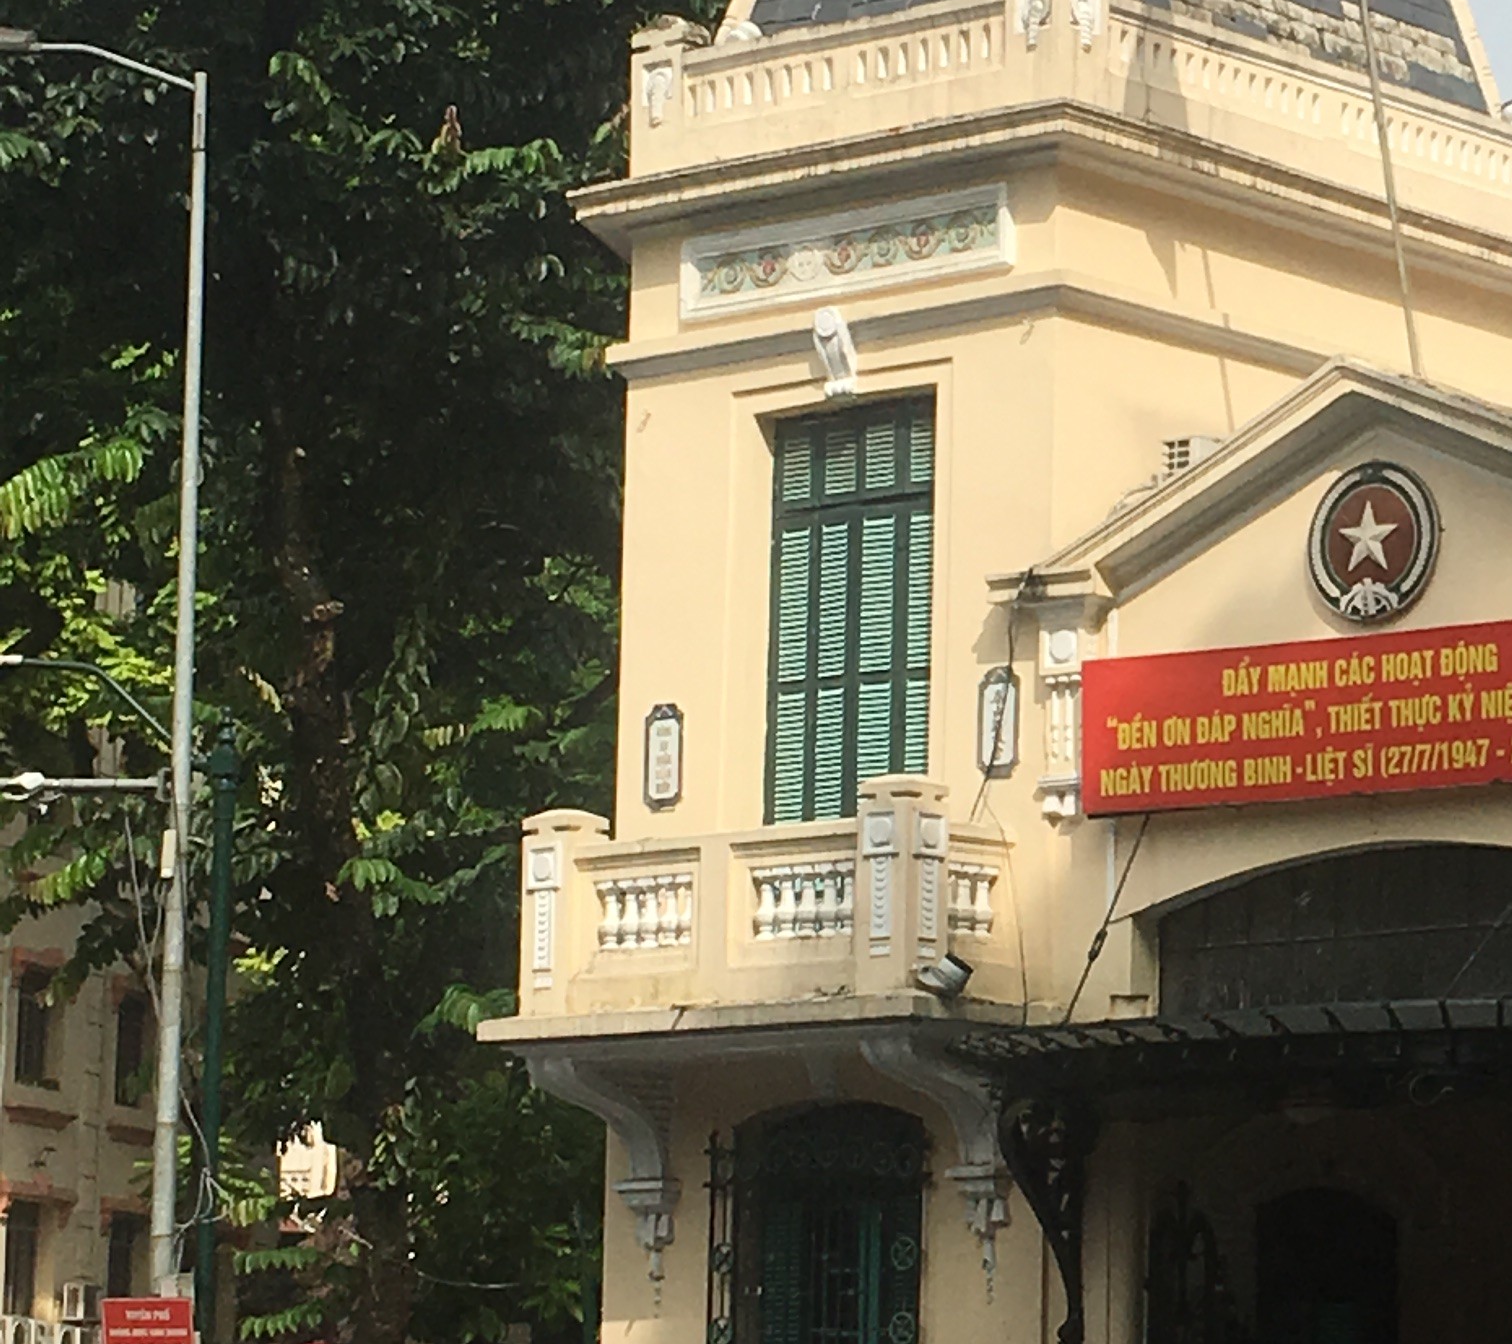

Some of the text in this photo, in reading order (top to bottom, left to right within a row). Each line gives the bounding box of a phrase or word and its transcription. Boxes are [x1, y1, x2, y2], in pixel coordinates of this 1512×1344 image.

[1222, 641, 1498, 697] ĐẨY MẠNH CÁC HOẠT ĐỘNG
[1163, 716, 1191, 747] ƠN
[1196, 710, 1236, 744] ĐÁP
[1327, 693, 1383, 734] THIẾT
[1389, 693, 1442, 732] THỰC
[1448, 683, 1475, 723] KỶ
[1100, 761, 1153, 797] NGÀY
[1159, 758, 1237, 792] THƯƠNG
[1243, 755, 1291, 786] BINH
[1305, 747, 1348, 786] LIỆT
[1352, 743, 1374, 778] SĨ
[1380, 738, 1490, 778] (27/7/1947
